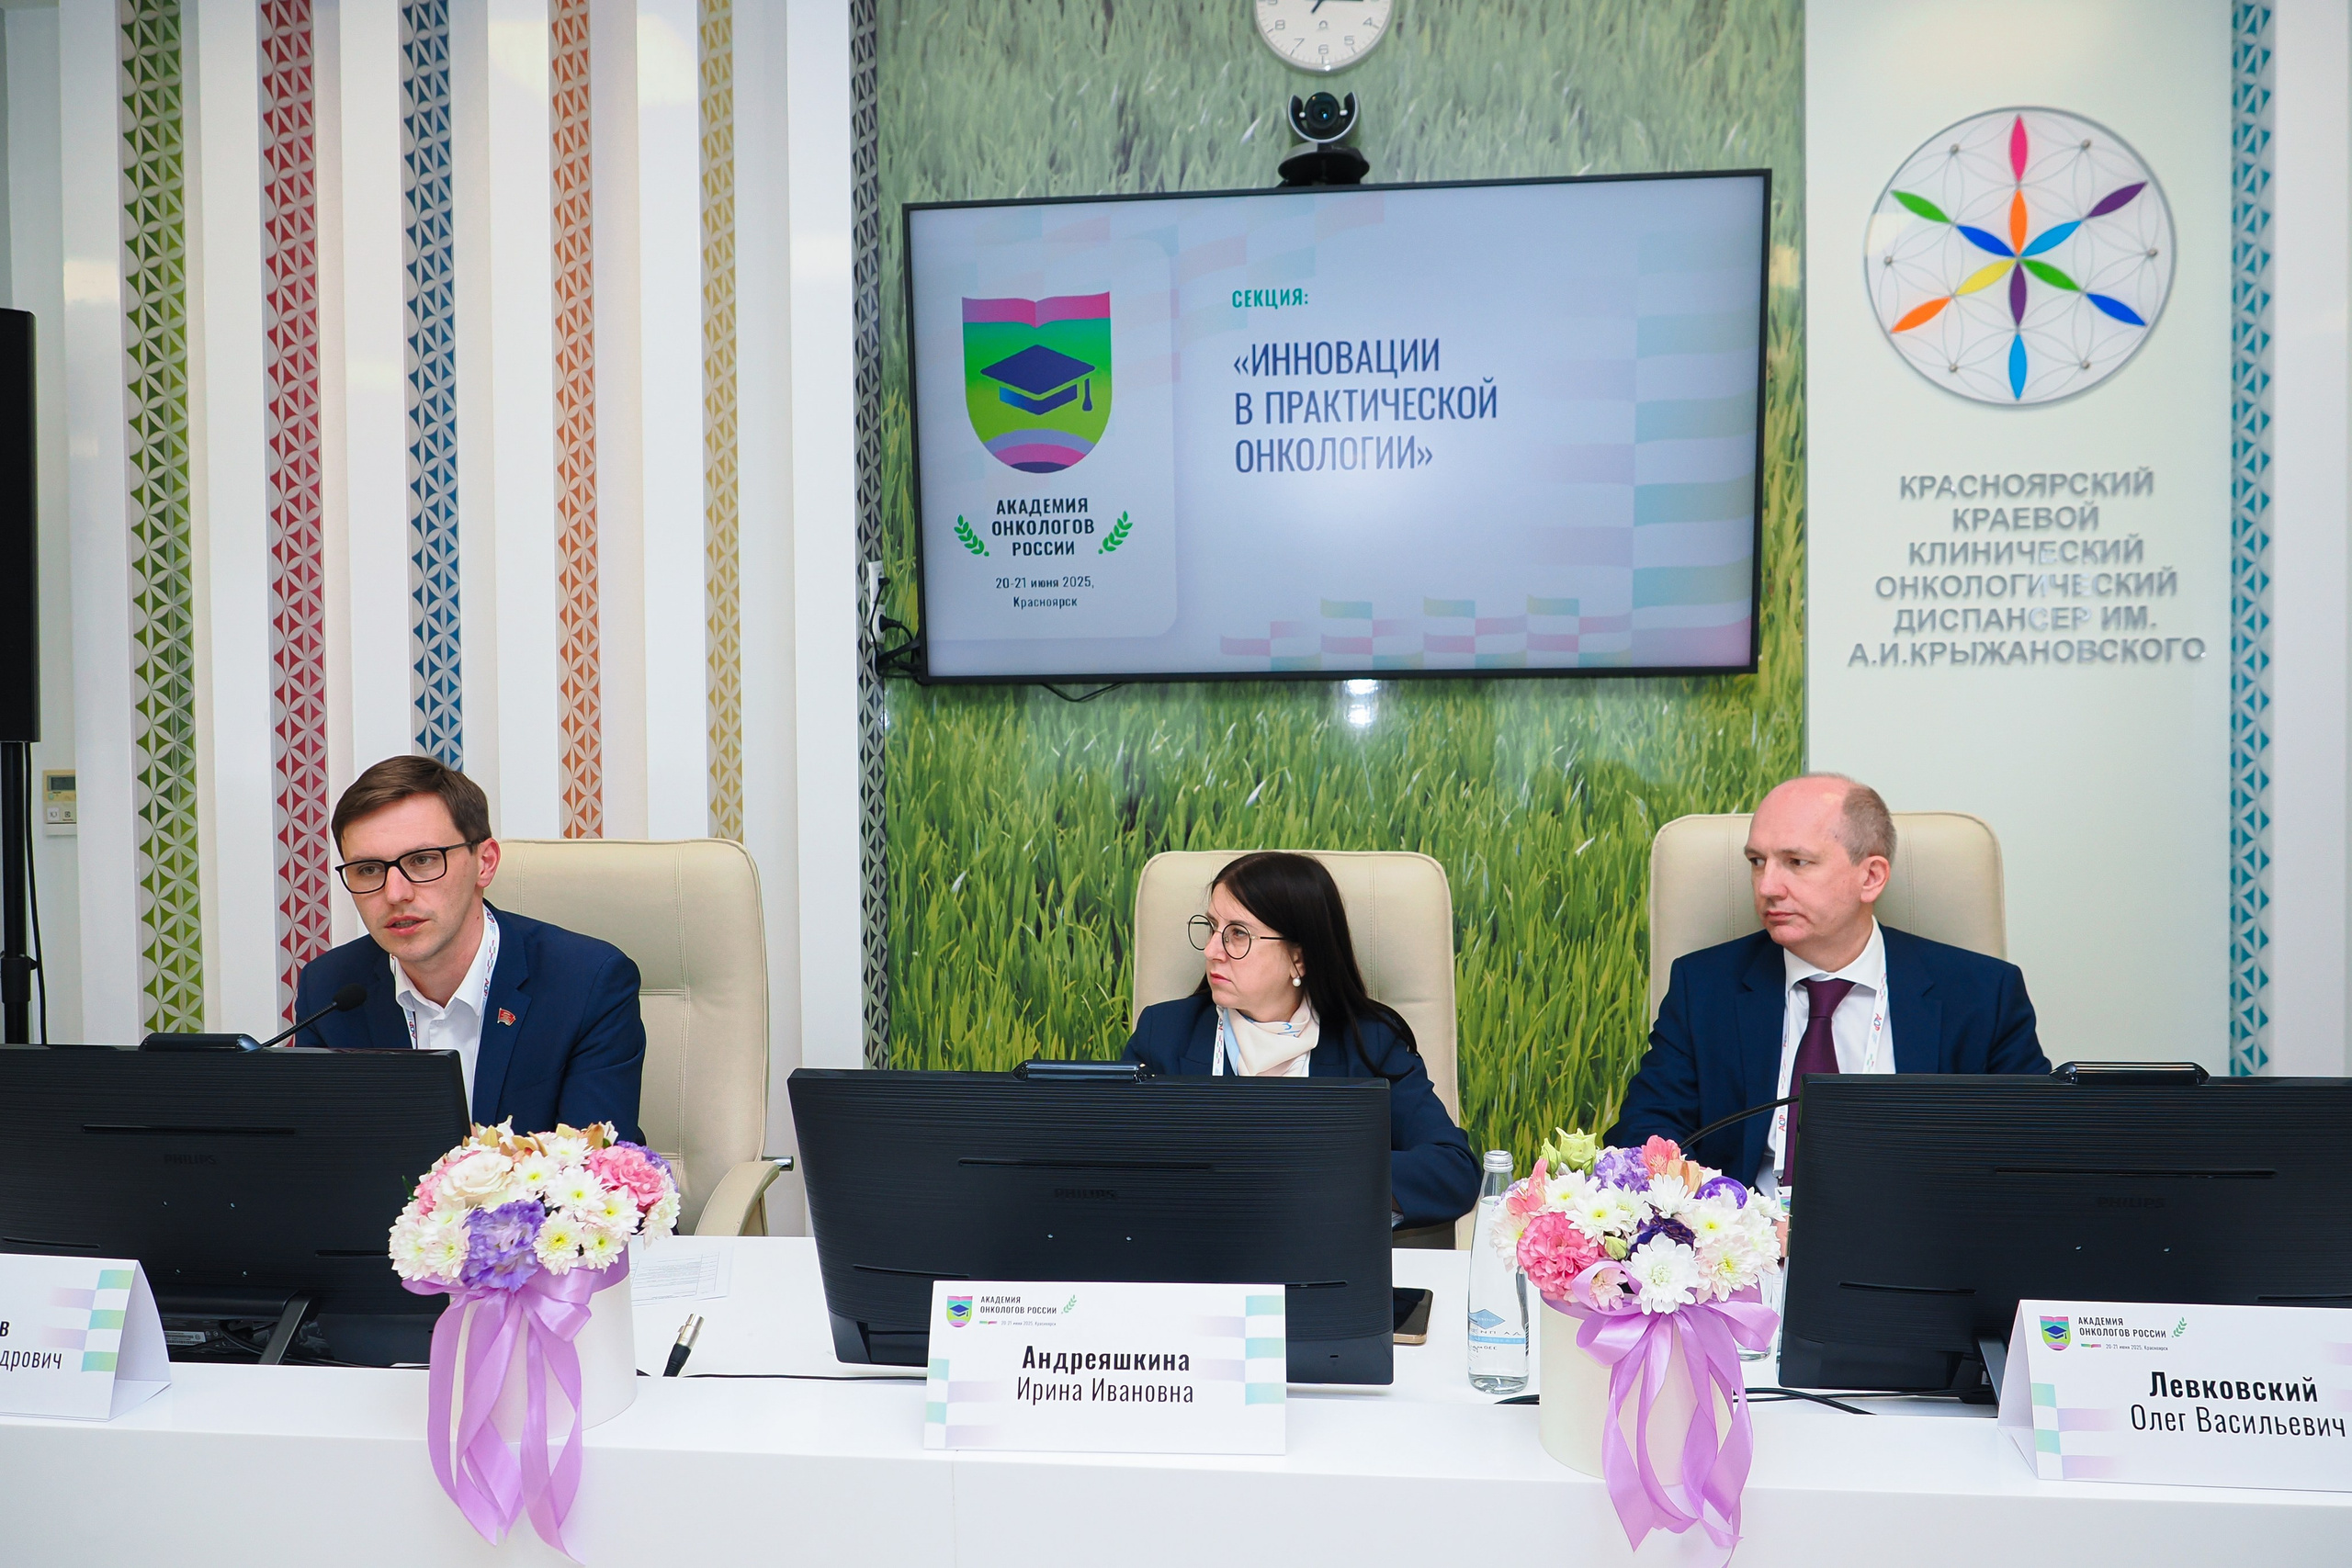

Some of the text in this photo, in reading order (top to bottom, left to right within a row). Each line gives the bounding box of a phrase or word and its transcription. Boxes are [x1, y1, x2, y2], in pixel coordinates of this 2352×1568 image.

[1275, 19, 1285, 30] 8
[1363, 17, 1373, 27] 4
[1294, 38, 1305, 48] 7
[1317, 44, 1329, 55] 6
[1344, 36, 1354, 46] 5
[1232, 288, 1308, 310] СЕКЦИЯ:
[1233, 338, 1439, 378] «ИННОВАЦИИ
[1235, 377, 1498, 425] В ПРАКТИЧЕСКОЙ
[1235, 435, 1433, 474] ОНКОЛОГИИ»
[1900, 466, 2154, 500] КРАСНОЯРСКИЙ
[996, 498, 1088, 516] АКАДЕМИЯ
[1952, 501, 2100, 533] КРАЕВОЙ
[992, 518, 1095, 536] ОНКОЛОГОВ
[1012, 540, 1075, 557] РОССИИ
[1908, 533, 2144, 566] КЛИНИЧЕСКИЙ
[996, 576, 1094, 590] 20-21 июня 2025,
[1875, 566, 2177, 599] ОНКОЛОГИЧЕСКИЙ
[1013, 597, 1077, 610] Красноярск
[1894, 605, 2157, 635] ДИСПАНСЕР ИМ.
[1847, 637, 2205, 667] А.И.КРЫЖАНОВСКОГО
[981, 1296, 1021, 1304] АКАДЕМИЯ
[1027, 1306, 1057, 1314] РОССИИ
[2078, 1316, 2124, 1326] АКАДЕМИЯ
[2079, 1327, 2166, 1338] ОНКОЛОГОВ РОССИИ
[1022, 1346, 1190, 1374] Андреяшкина
[1016, 1377, 1193, 1406] Ирина Ивановна
[2149, 1371, 2319, 1403] Левковский
[2131, 1404, 2346, 1438] Олег Васильевич
